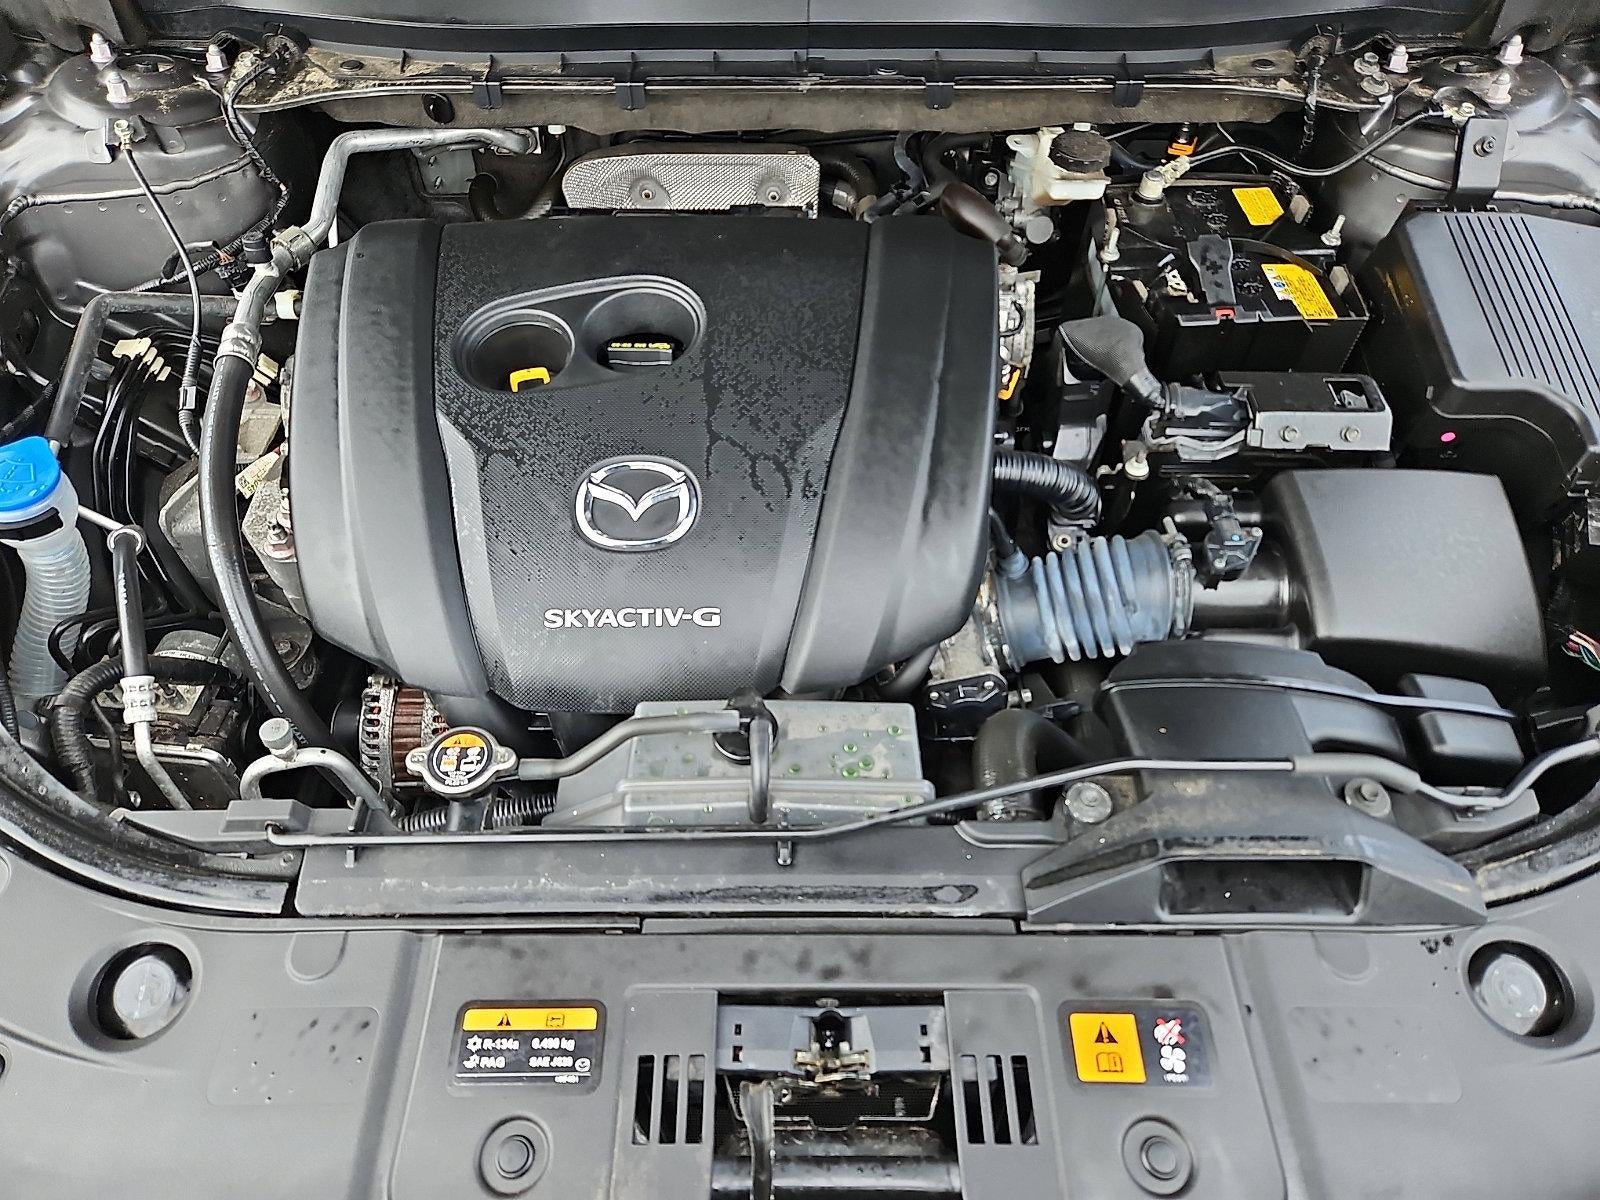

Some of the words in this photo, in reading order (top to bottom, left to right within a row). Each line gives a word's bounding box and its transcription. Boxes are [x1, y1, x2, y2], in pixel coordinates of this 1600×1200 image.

[543, 607, 721, 629] SKYACTIV-G
[483, 1038, 520, 1050] R-134a
[560, 1037, 576, 1052] kg
[480, 1056, 506, 1069] PAG
